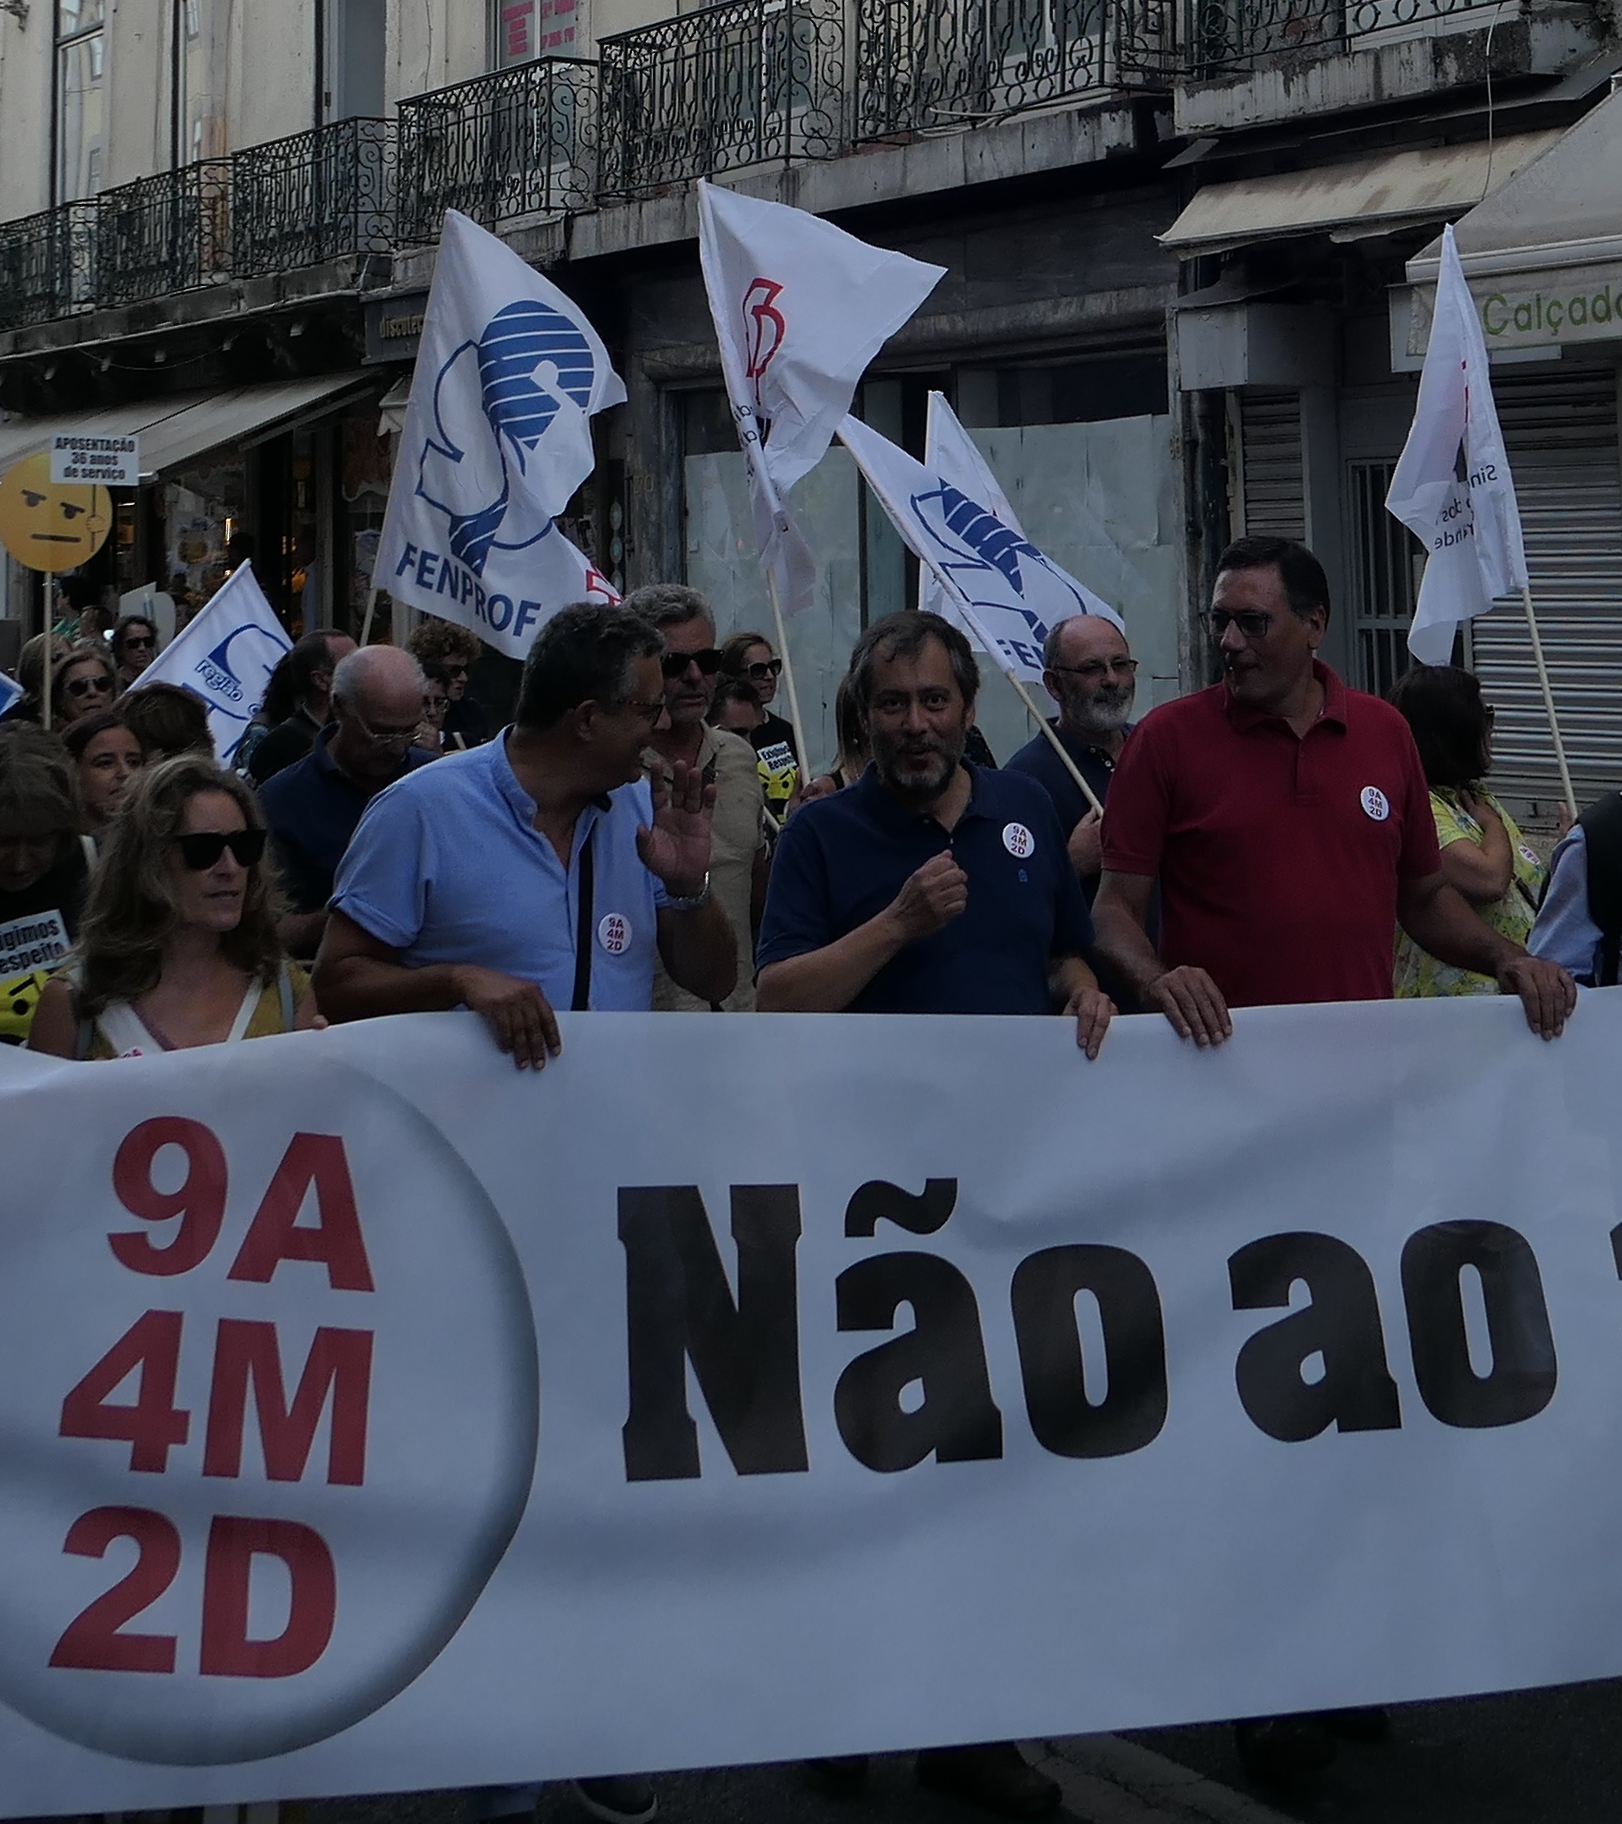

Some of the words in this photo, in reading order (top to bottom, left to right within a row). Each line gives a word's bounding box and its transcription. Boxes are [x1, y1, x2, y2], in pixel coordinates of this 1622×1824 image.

[55, 436, 135, 453] APOSENTAÇÃO
[90, 454, 118, 466] anos
[64, 465, 78, 478] de
[81, 466, 126, 481] serviço
[395, 541, 542, 638] FENPROF
[194, 659, 244, 703] região
[1011, 844, 1025, 855] 2D
[608, 917, 624, 929] 9A
[607, 928, 624, 940] 4M
[607, 939, 623, 951] 2D
[107, 1114, 376, 1294] 9A
[617, 1176, 1170, 1482] Não
[1227, 1218, 1558, 1444] ao
[58, 1308, 376, 1488] 4M
[47, 1504, 337, 1679] 2D
